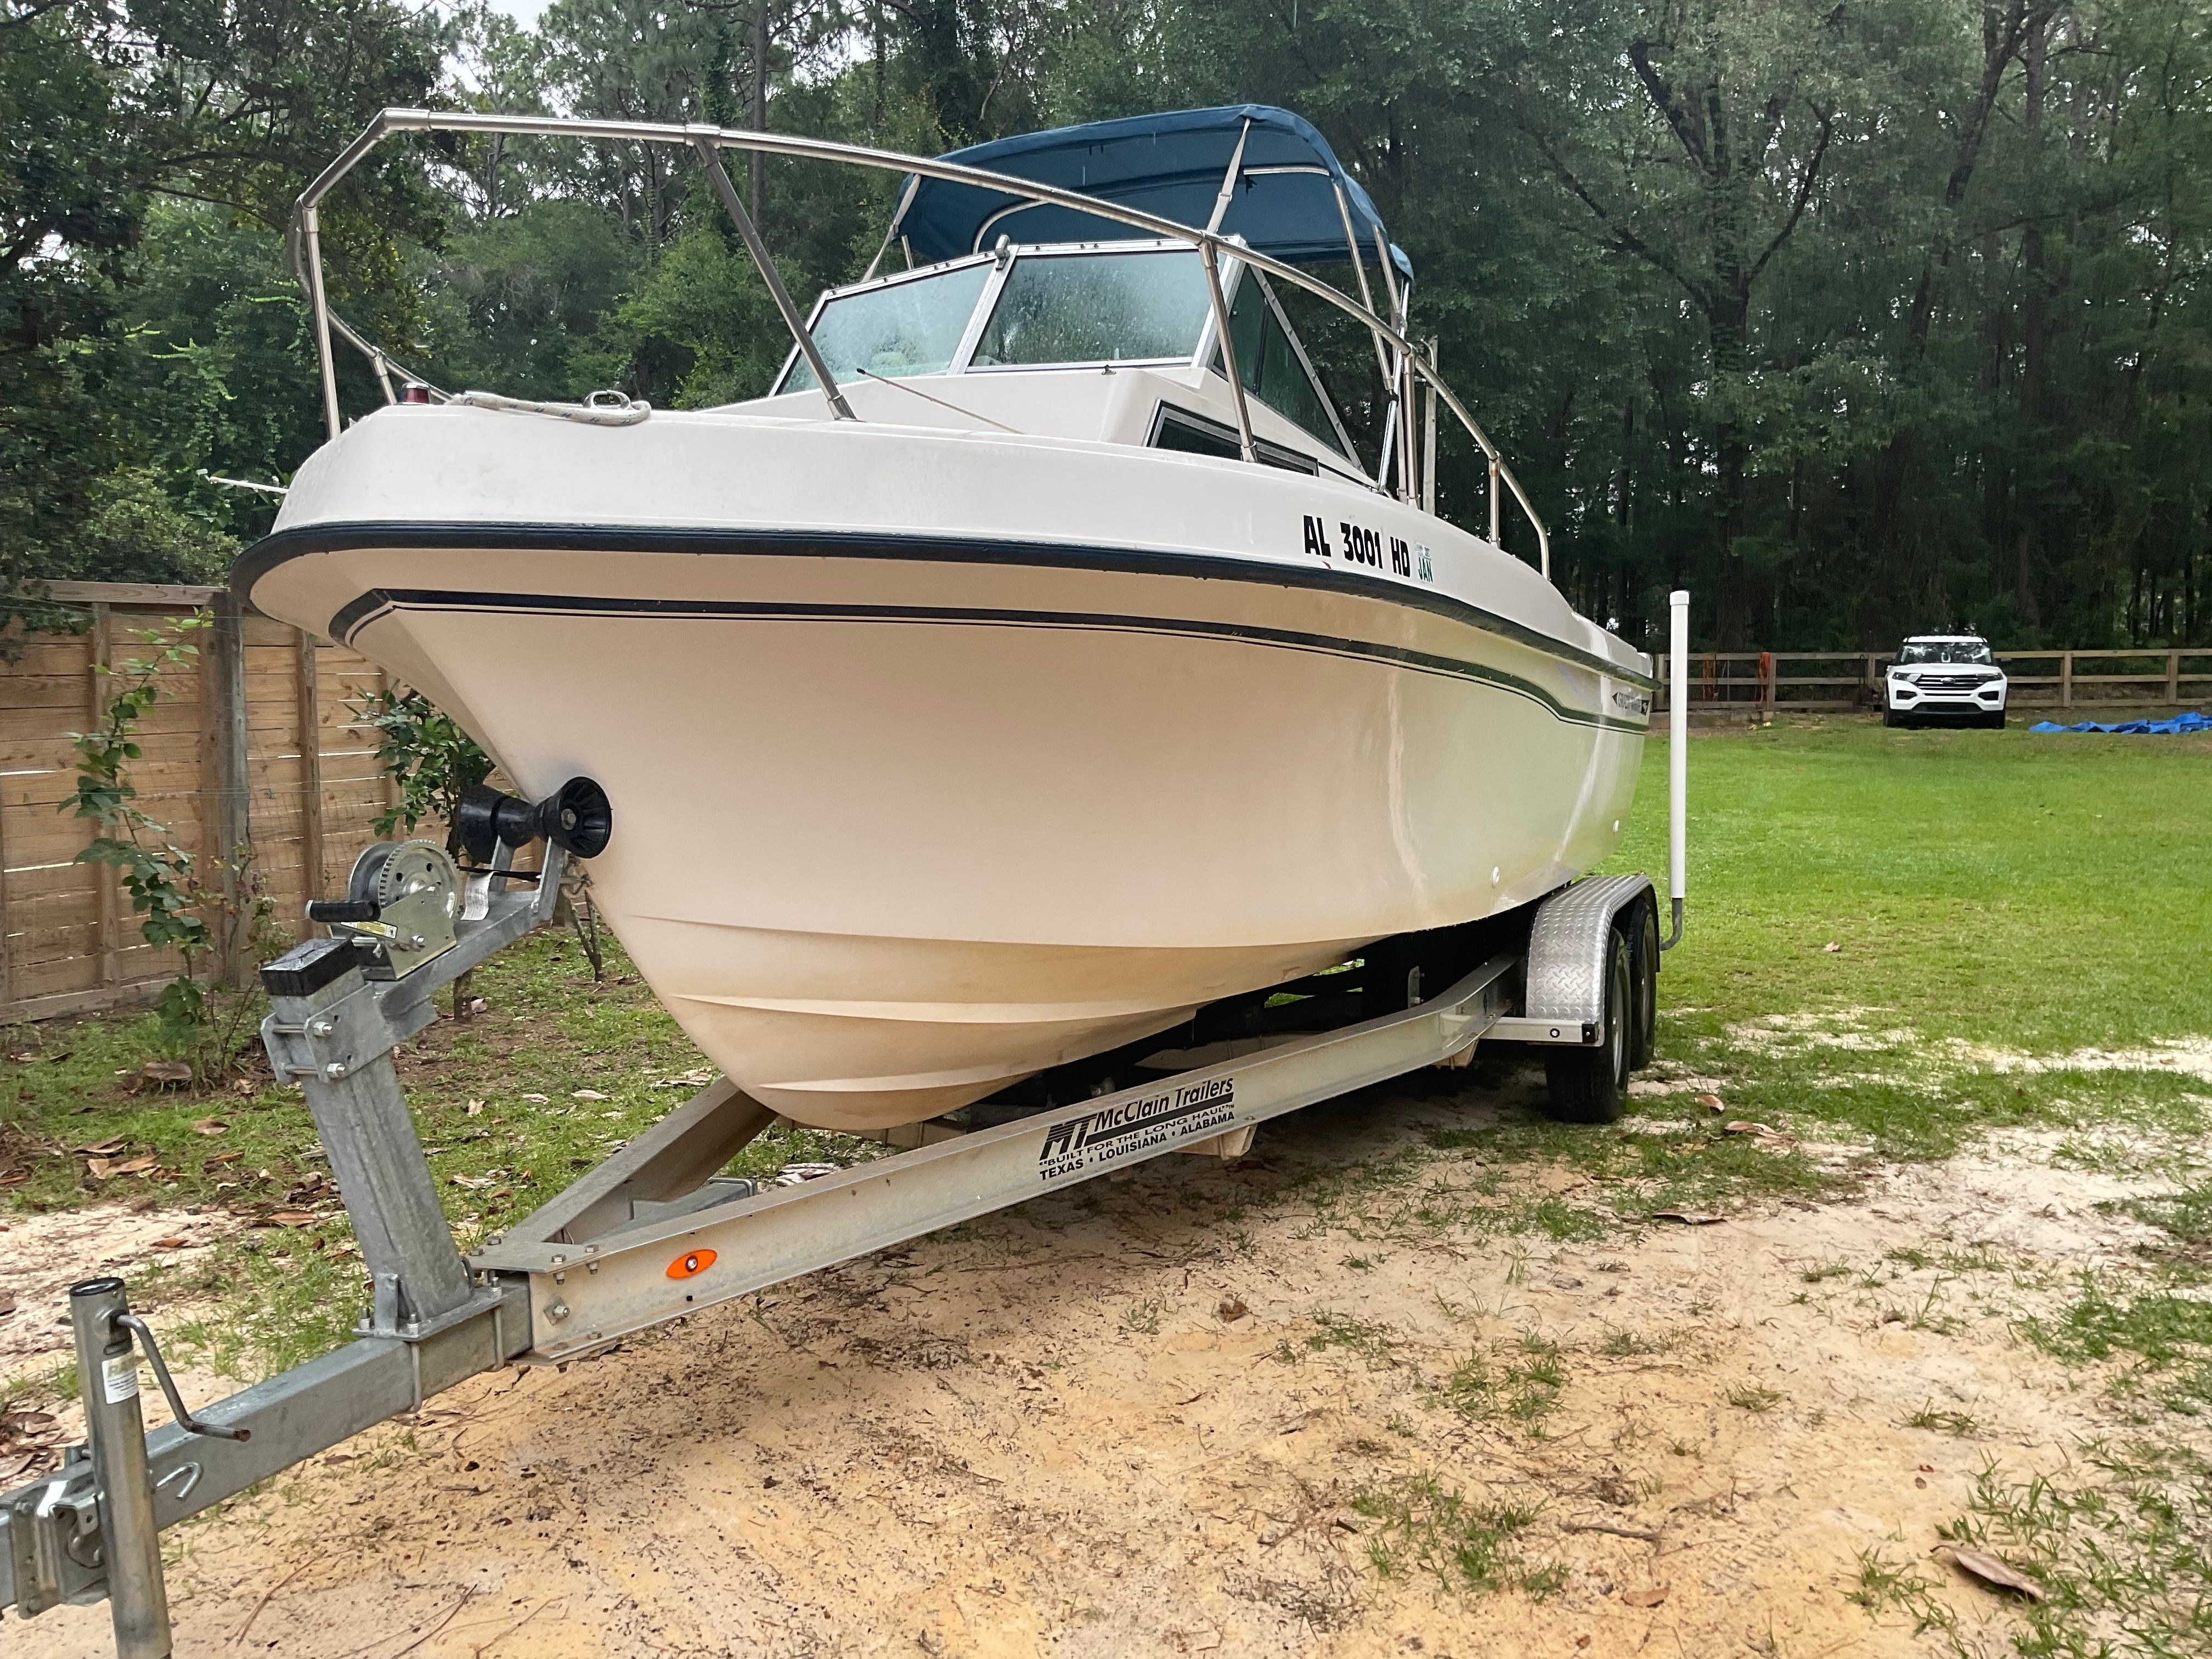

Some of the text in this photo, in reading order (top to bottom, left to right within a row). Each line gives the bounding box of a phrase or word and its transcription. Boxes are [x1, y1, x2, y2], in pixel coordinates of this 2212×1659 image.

[1303, 515, 1410, 578] AL 3001 HD
[1418, 557, 1434, 583] JAN
[1094, 1077, 1233, 1132] McClain Trailers
[1039, 1111, 1235, 1181] TEXAS LOUISIANA ALABAMA
[1087, 1141, 1108, 1154] FOR
[1116, 1132, 1140, 1144] THE
[1145, 1118, 1188, 1136] LONG
